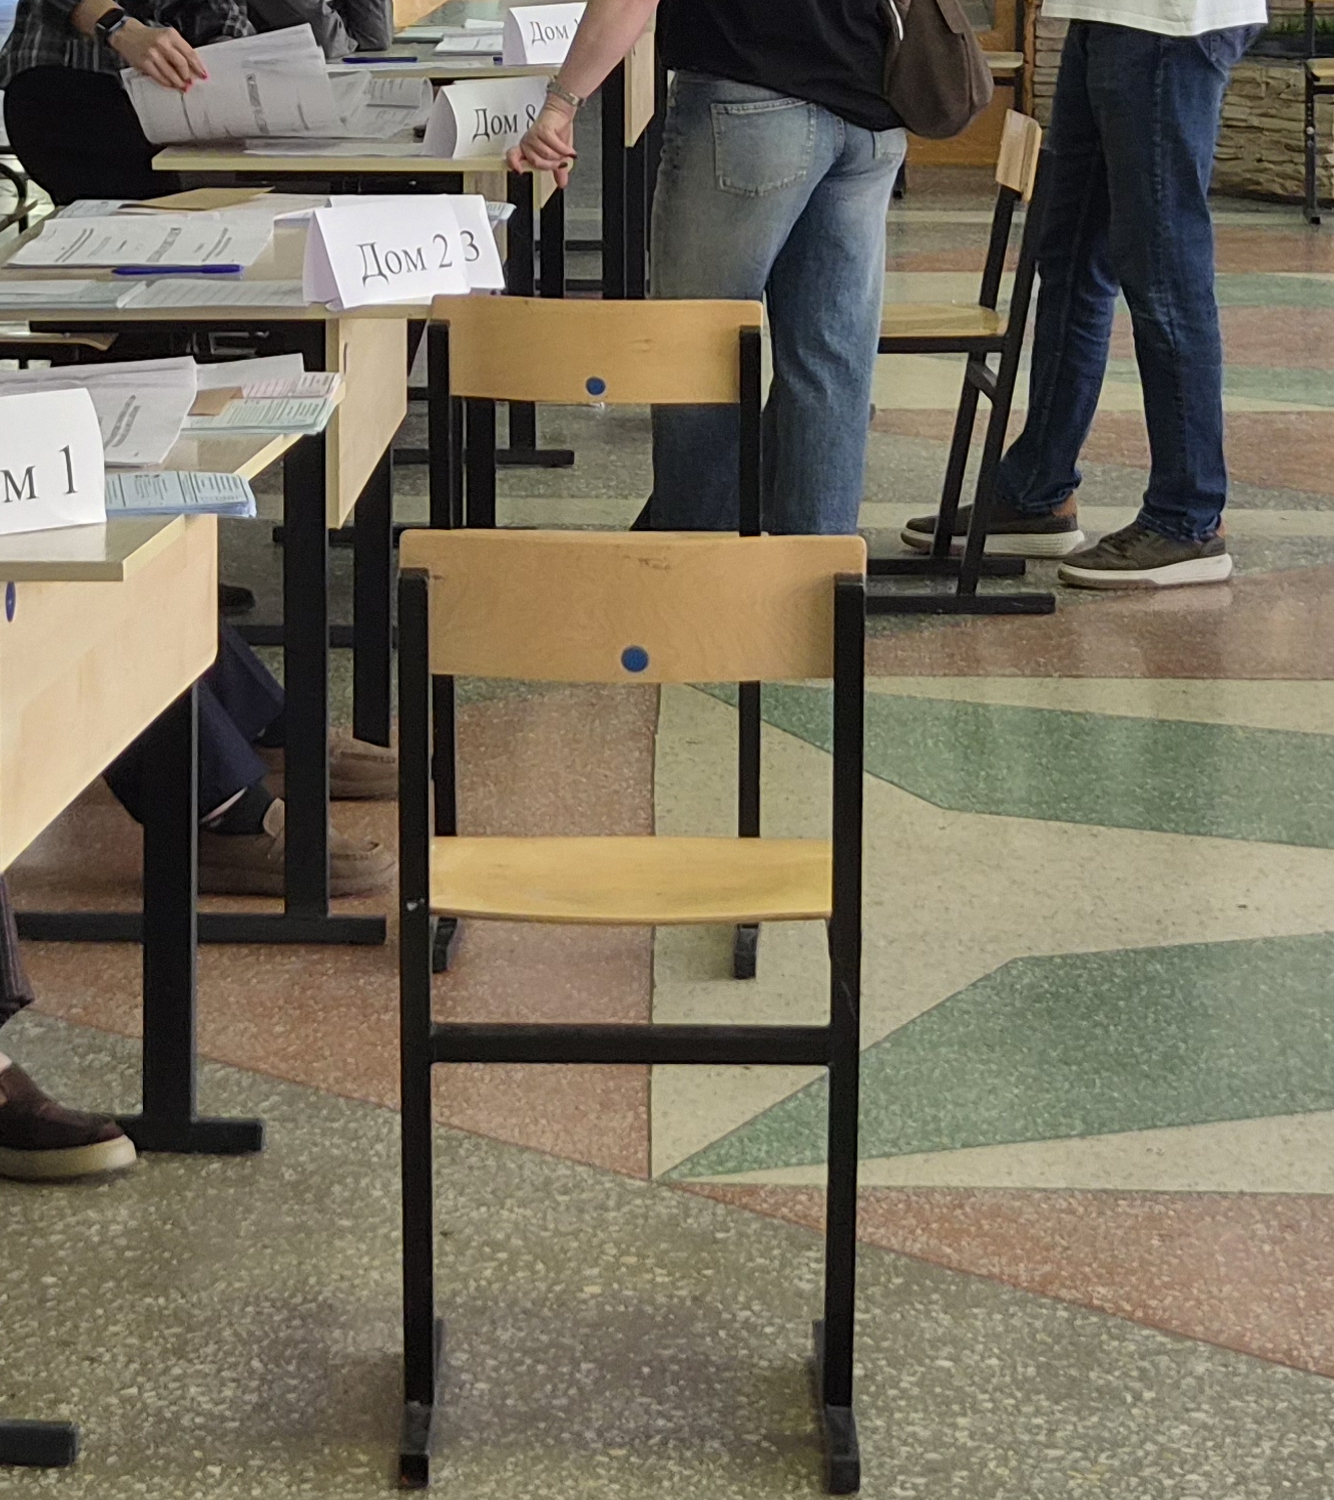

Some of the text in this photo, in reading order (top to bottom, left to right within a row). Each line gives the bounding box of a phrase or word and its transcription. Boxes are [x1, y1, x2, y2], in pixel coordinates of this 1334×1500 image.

[528, 21, 569, 46] Дом
[471, 107, 518, 143] Дом
[356, 233, 453, 287] Дом 2
[459, 230, 481, 262] 3
[59, 444, 79, 495] 1
